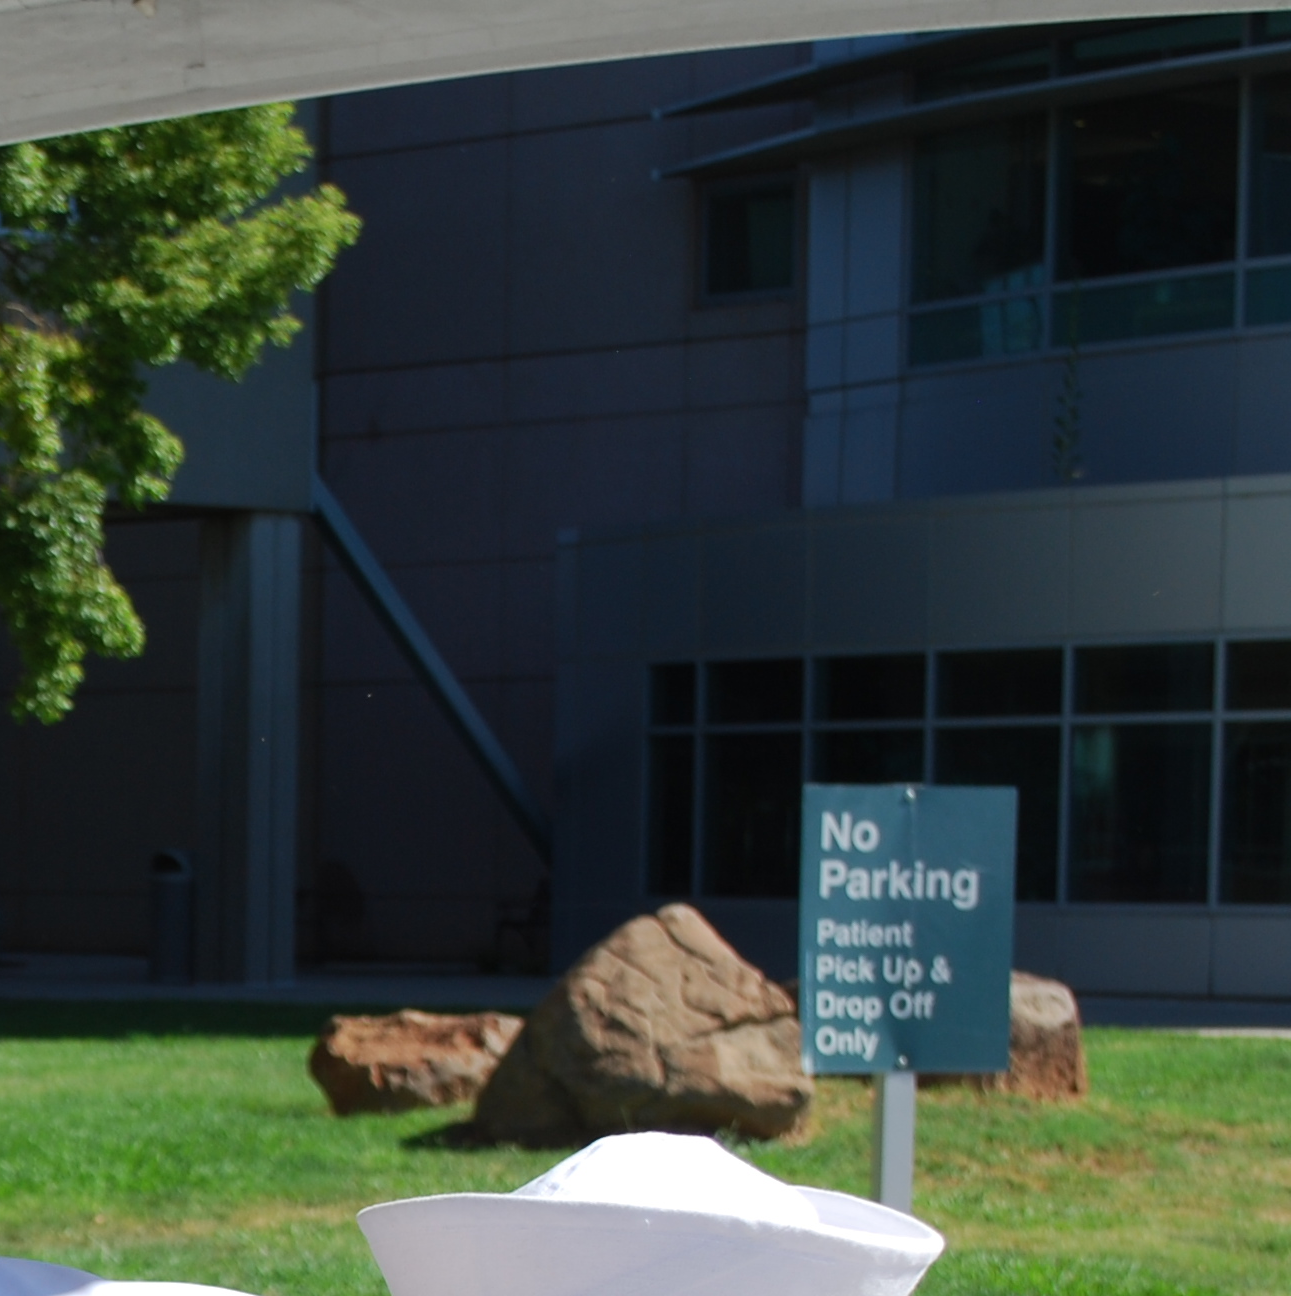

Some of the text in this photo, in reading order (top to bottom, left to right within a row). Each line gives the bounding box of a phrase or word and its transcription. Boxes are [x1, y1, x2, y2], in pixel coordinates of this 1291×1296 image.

[820, 811, 880, 852] No
[819, 858, 980, 910] Parking
[817, 918, 914, 947] Patient
[816, 954, 952, 990] Pick Up &
[815, 990, 936, 1026] Drop Off
[815, 1025, 880, 1062] Only
